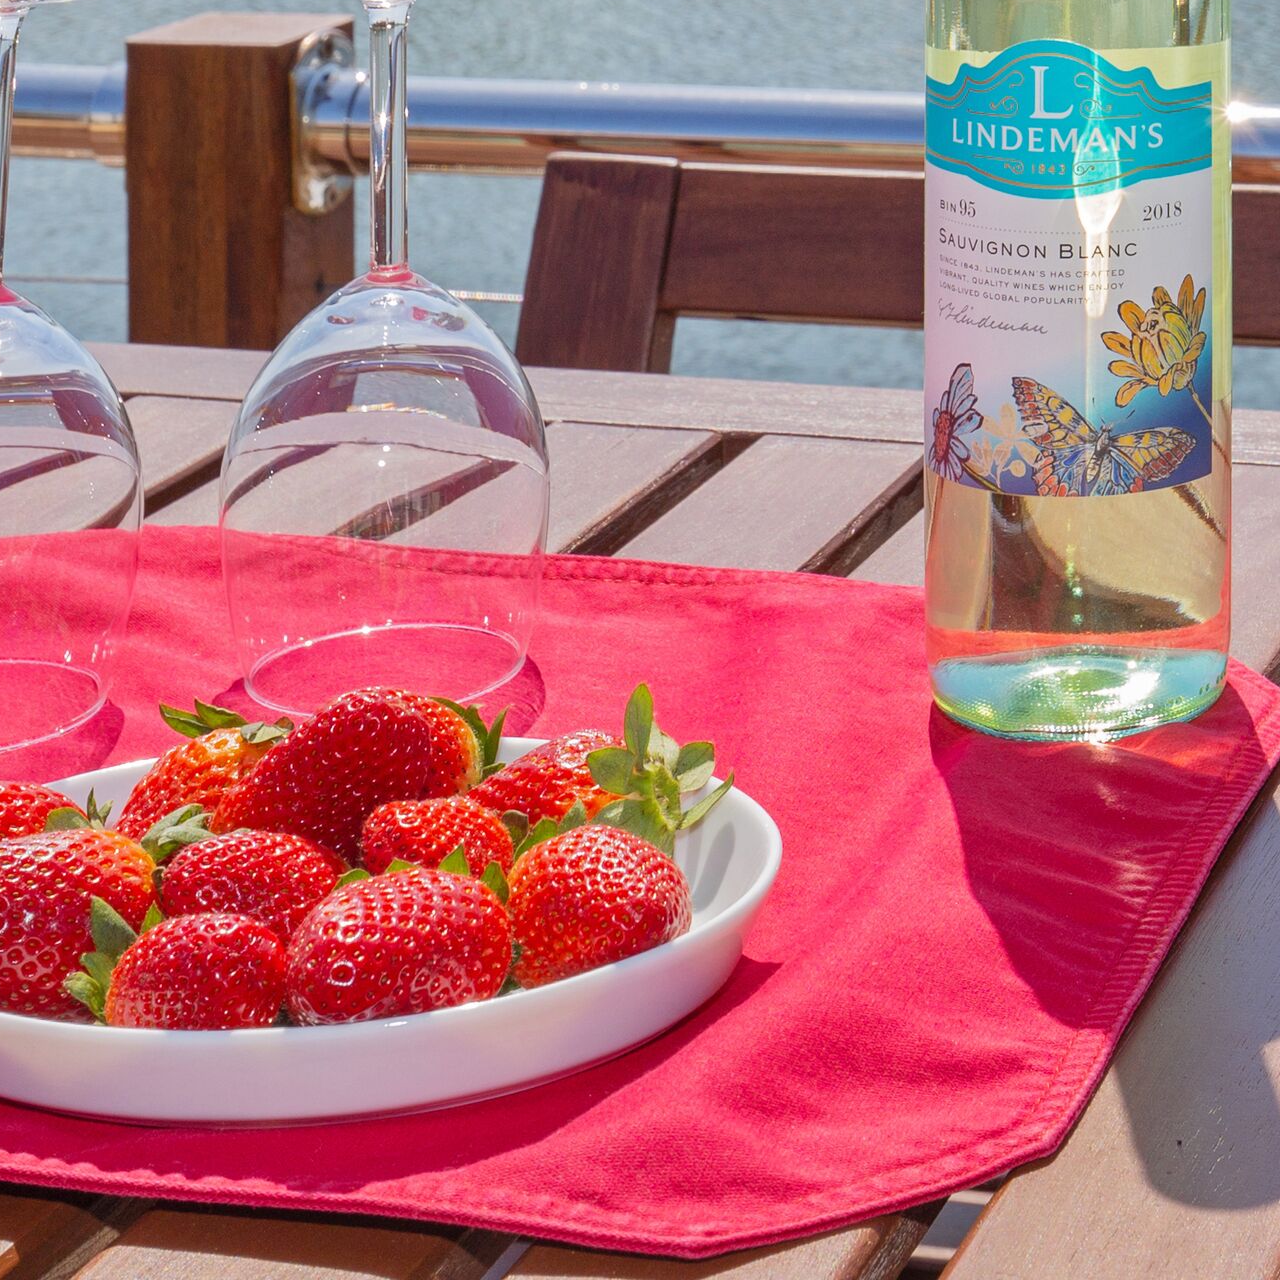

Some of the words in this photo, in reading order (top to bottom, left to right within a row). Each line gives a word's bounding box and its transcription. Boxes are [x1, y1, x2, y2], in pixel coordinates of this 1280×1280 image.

[1029, 65, 1073, 119] L
[952, 118, 1163, 153] LINDEMAN'S
[1030, 163, 1066, 175] 1843
[939, 199, 957, 213] BIN
[959, 200, 976, 218] 95
[1142, 201, 1183, 221] 2018
[938, 227, 1047, 259] SAUVIGNON
[1059, 242, 1138, 260] BLANC
[939, 254, 958, 267] SINCE
[985, 266, 1046, 278] LINDEMAN'S
[1050, 271, 1071, 279] HAS
[972, 276, 1009, 289] QUALITY
[1013, 283, 1045, 291] WINES
[1088, 282, 1125, 291] ENJOY
[983, 291, 1020, 303] GLOBAL
